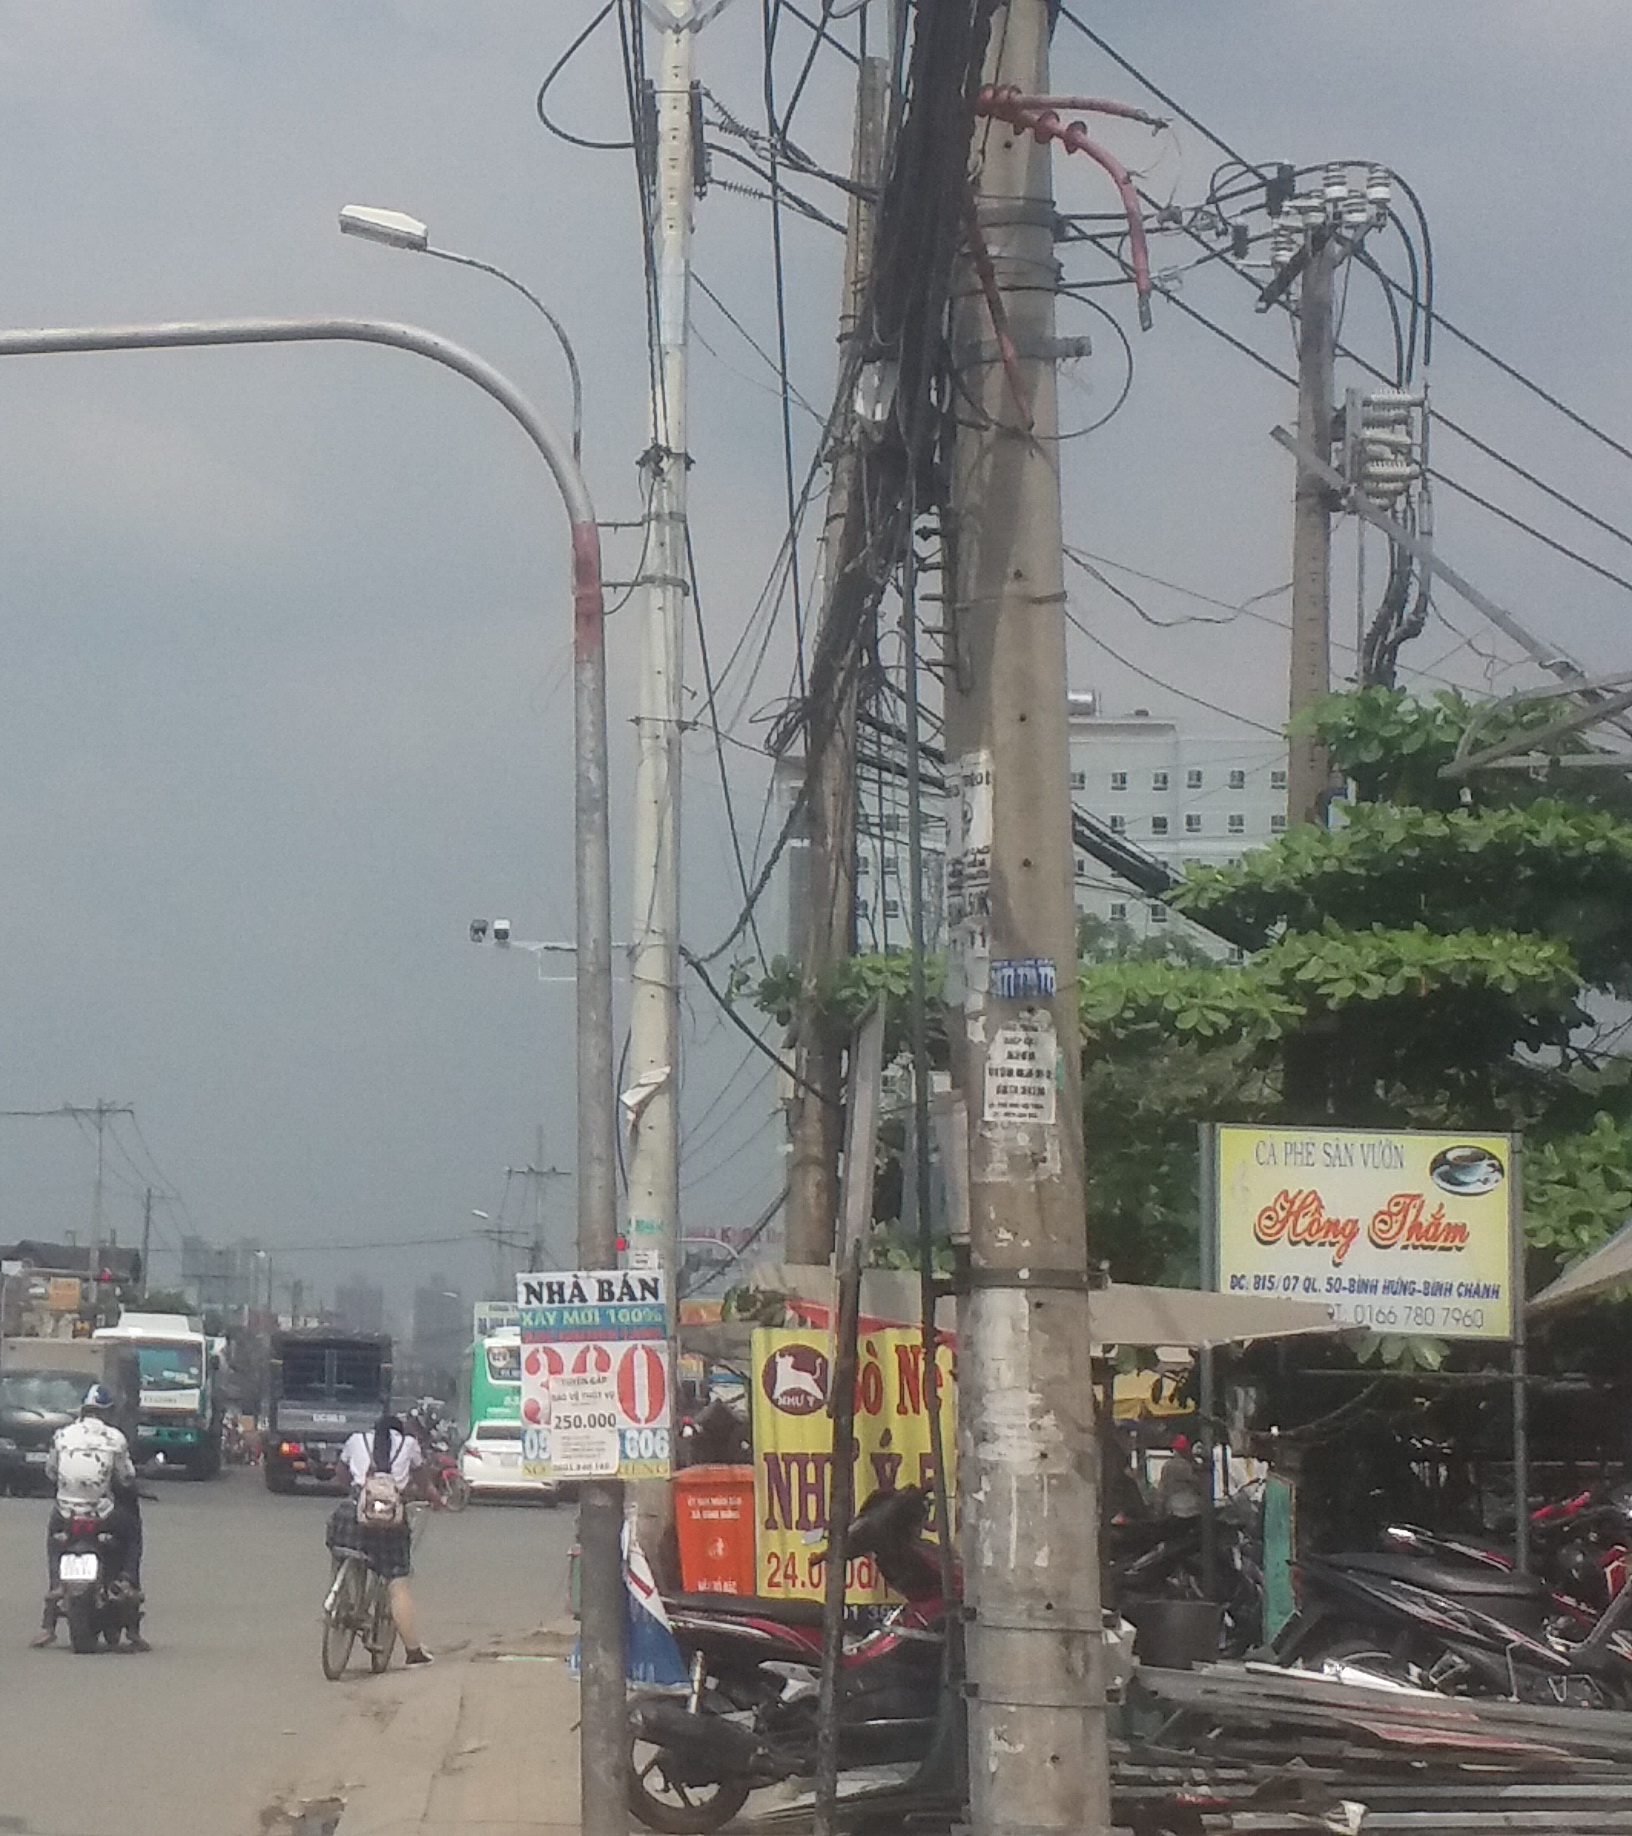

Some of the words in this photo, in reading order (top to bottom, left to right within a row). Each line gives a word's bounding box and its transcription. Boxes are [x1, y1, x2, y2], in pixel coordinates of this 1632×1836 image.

[1368, 1192, 1469, 1251] Thắm
[523, 1273, 588, 1305] NHÀ
[596, 1272, 660, 1303] BÁN
[1354, 1303, 1398, 1325] 0166
[1404, 1305, 1435, 1326] 780
[1442, 1307, 1484, 1329] 7960
[554, 1412, 617, 1431] 250.000
